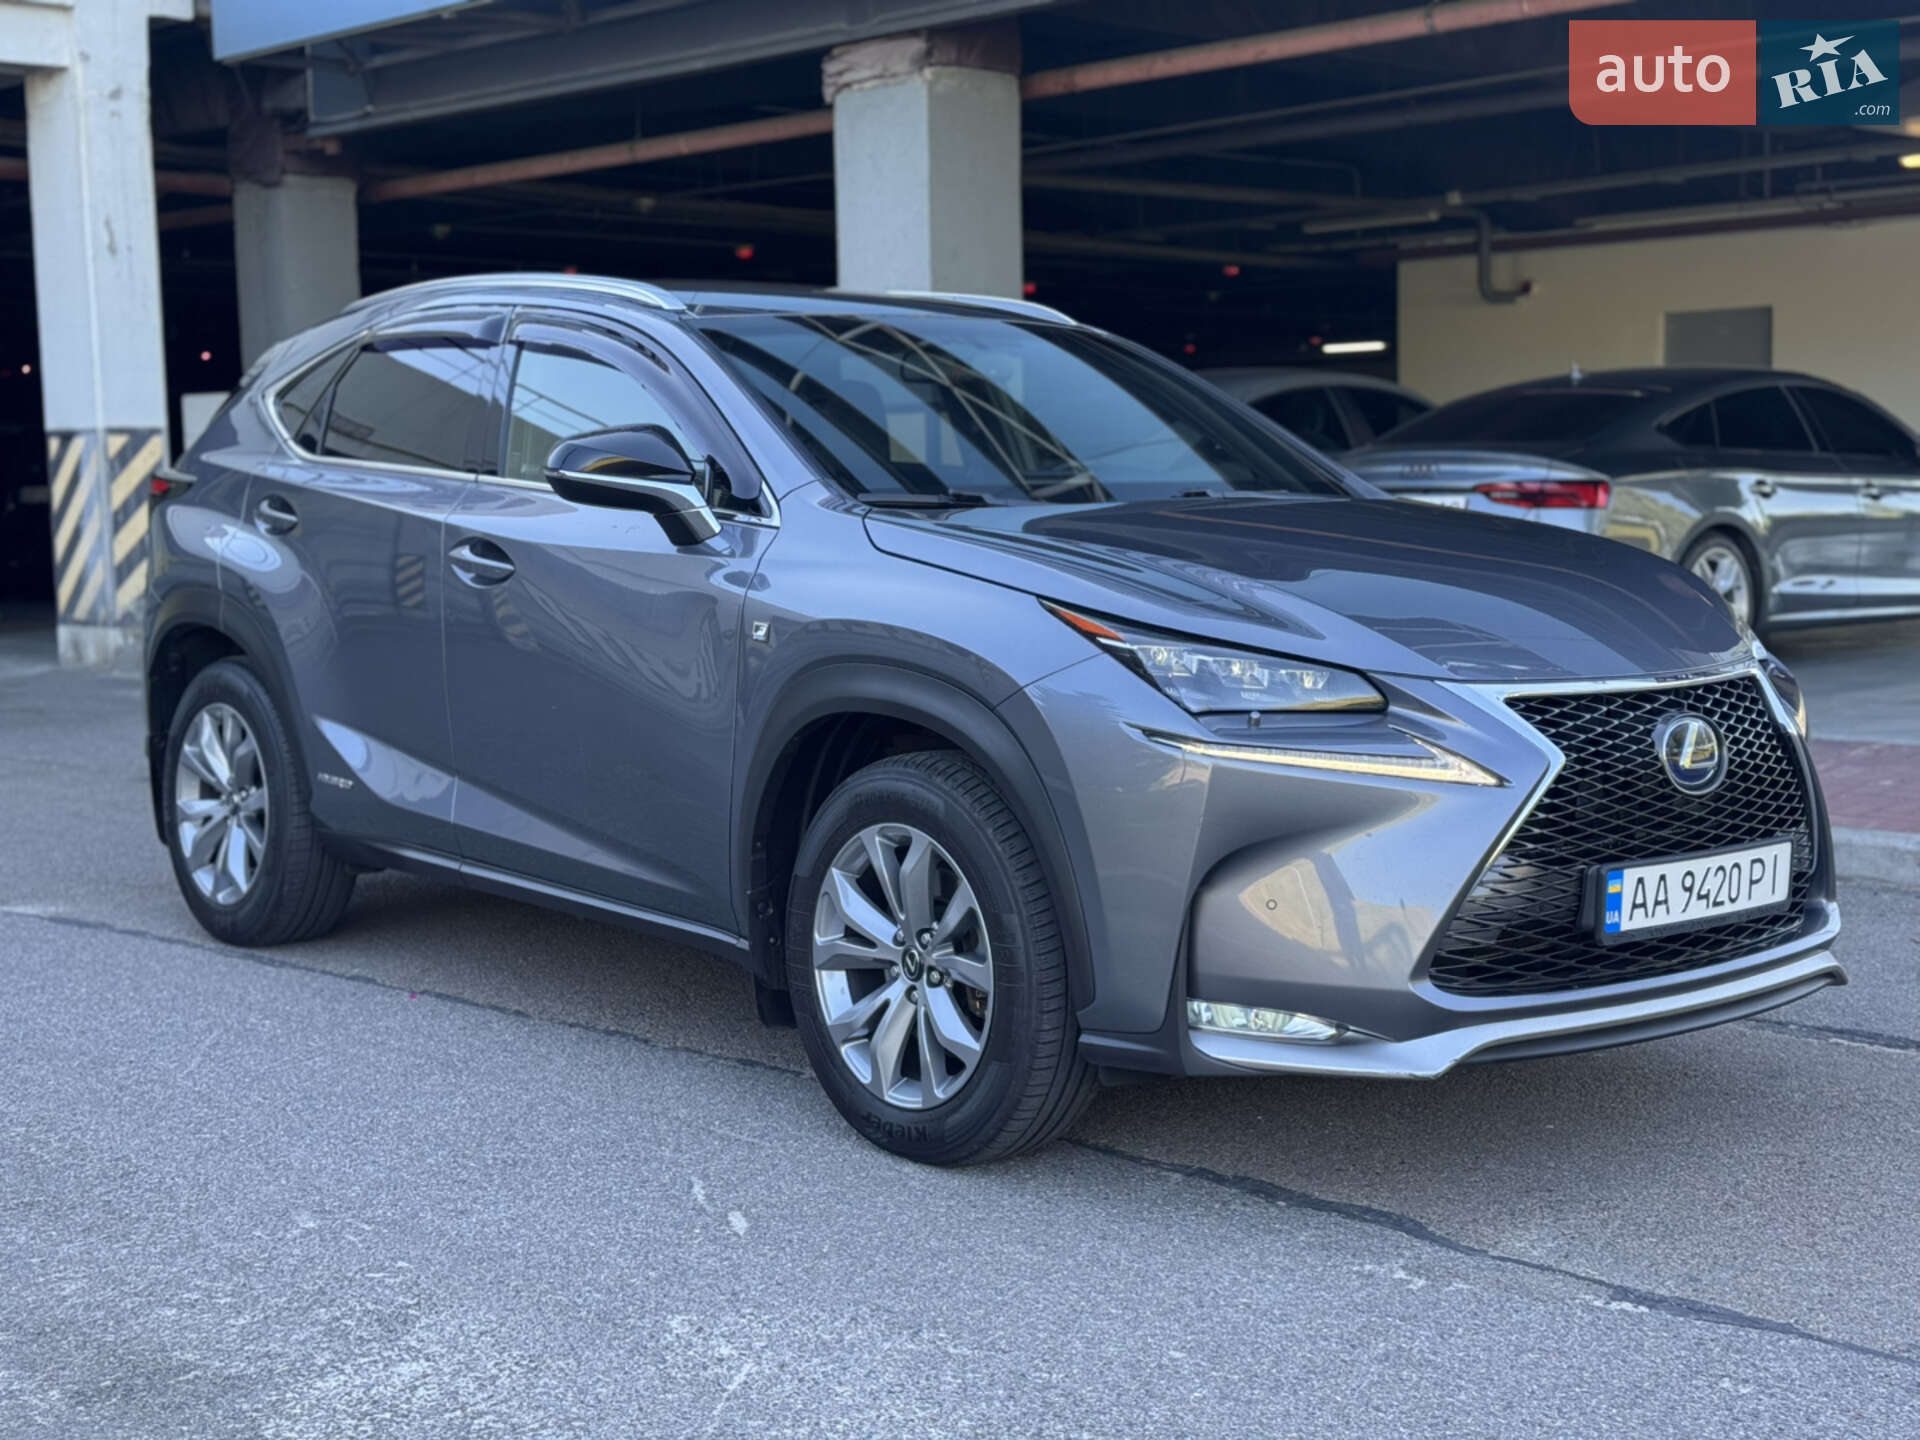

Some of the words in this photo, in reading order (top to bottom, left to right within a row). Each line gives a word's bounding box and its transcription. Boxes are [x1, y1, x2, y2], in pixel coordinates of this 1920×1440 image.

[1628, 873, 1671, 922] AA
[1680, 861, 1742, 914] 9420
[1748, 853, 1778, 901] PI
[1606, 910, 1620, 924] UA
